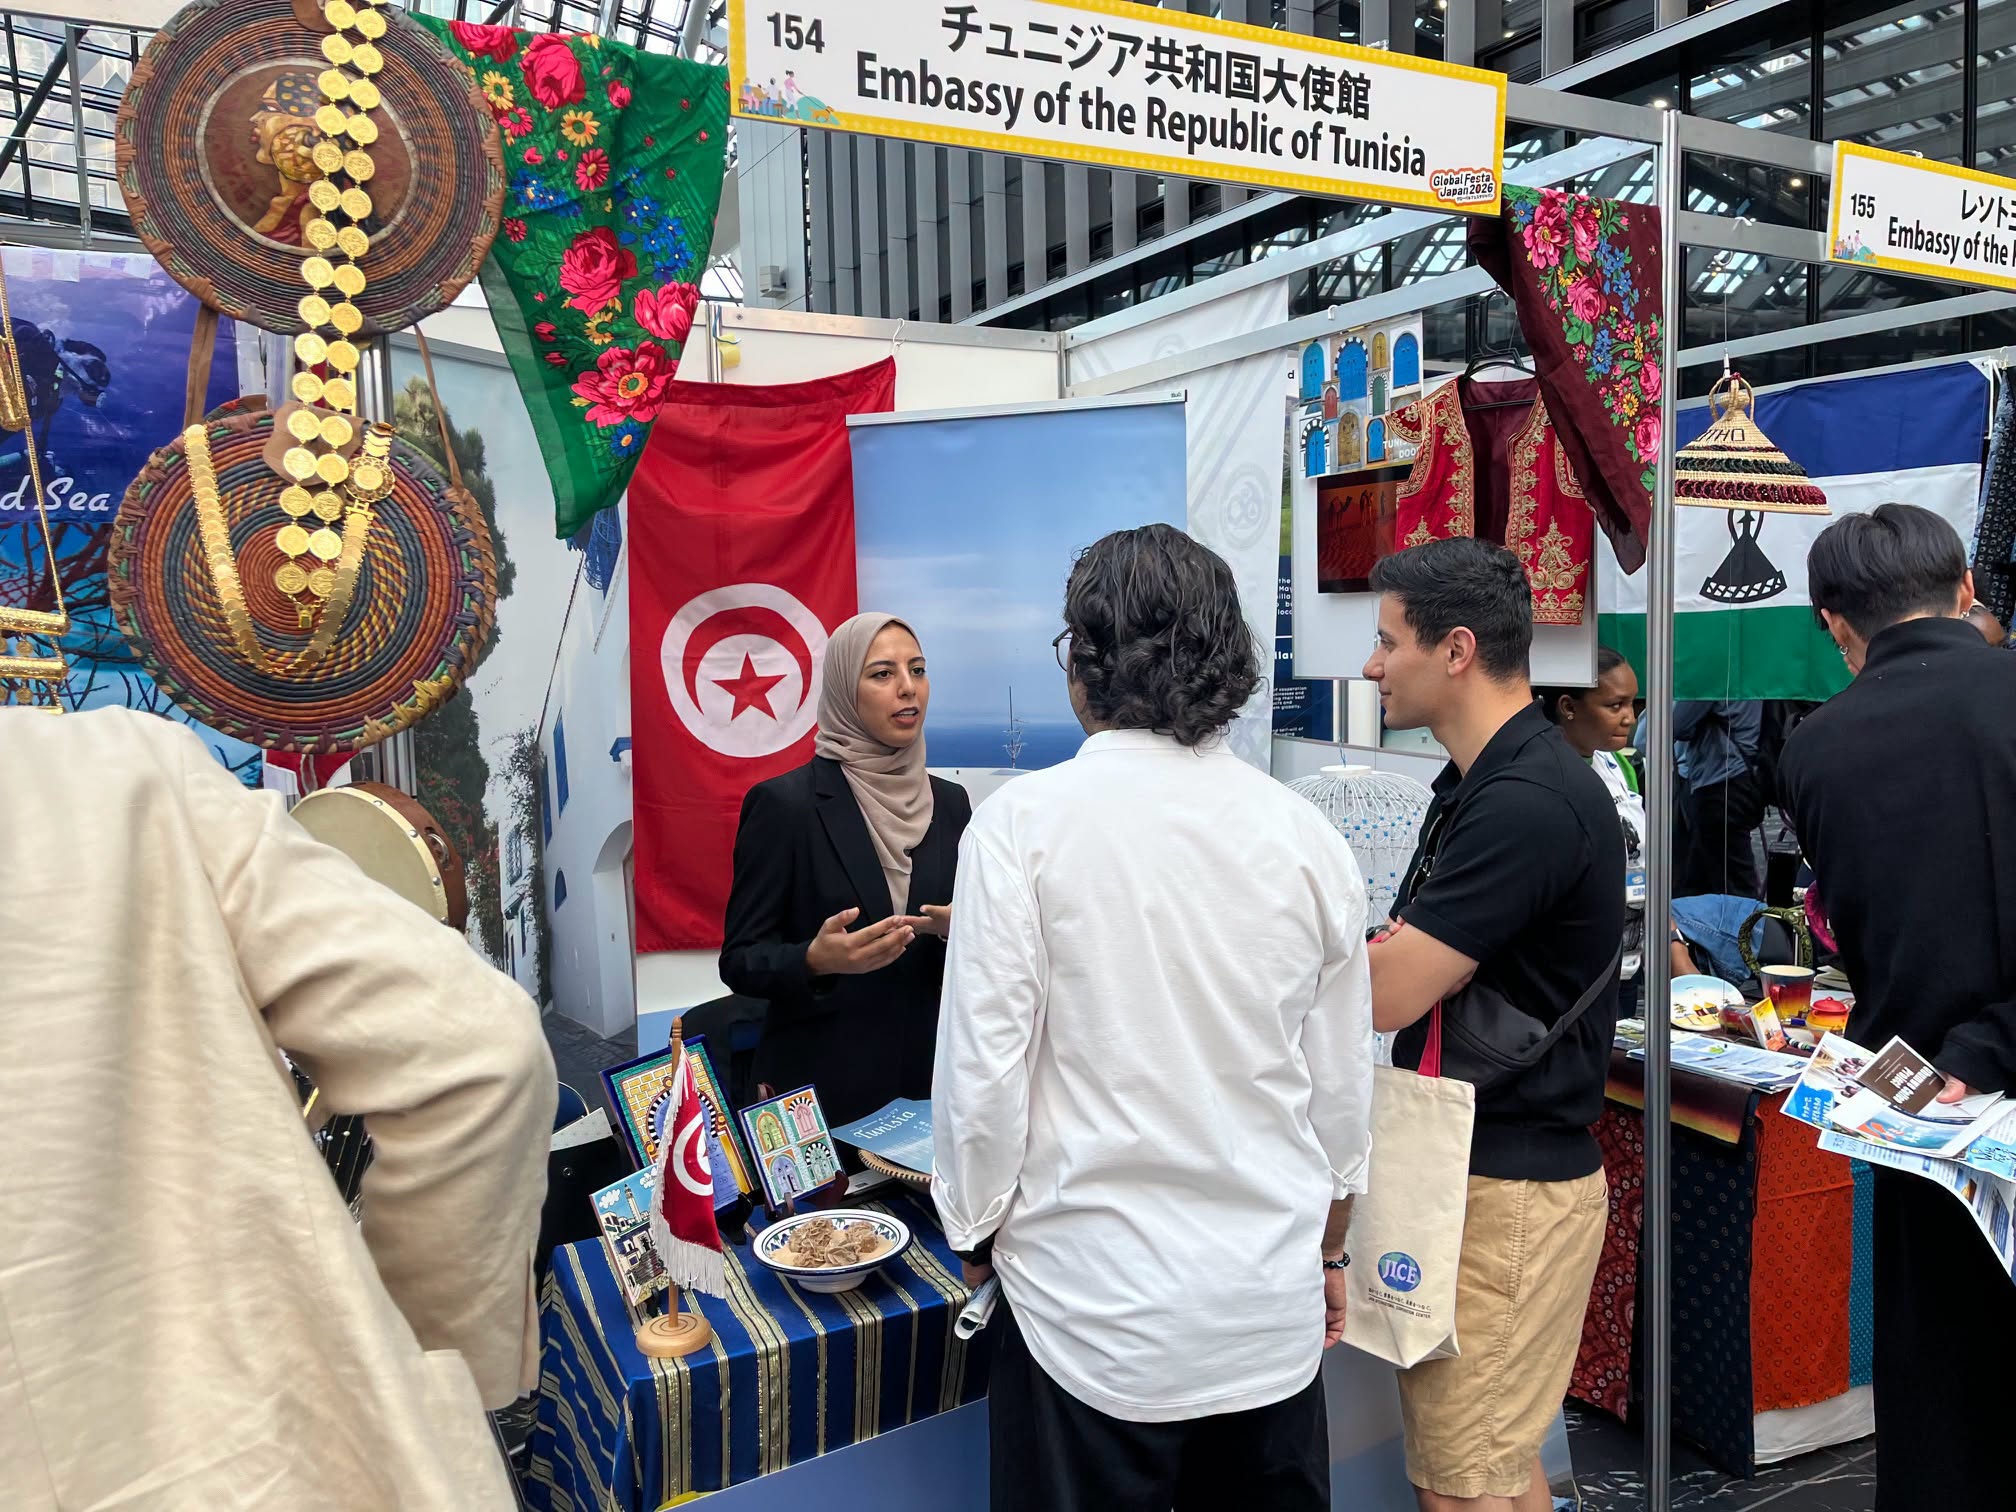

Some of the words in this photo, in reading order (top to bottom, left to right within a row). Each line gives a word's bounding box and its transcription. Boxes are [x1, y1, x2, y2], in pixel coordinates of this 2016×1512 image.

[766, 12, 825, 54] 154
[941, 4, 1371, 121] チュニジア共和国大使館
[857, 50, 1024, 131] Embassy
[1034, 81, 1072, 126] of
[1079, 86, 1136, 135] the
[1147, 96, 1283, 156] Republic
[1291, 120, 1323, 162] of
[1329, 124, 1426, 176] Tunisia
[1434, 174, 1463, 186] Global
[1464, 172, 1491, 186] Festa
[1440, 186, 1469, 197] Japan
[1469, 183, 1493, 194] 2026
[1851, 193, 1876, 218] 155
[1887, 216, 1960, 265] Embassy
[1963, 231, 1981, 260] of
[1983, 234, 2007, 266] the
[33, 477, 111, 512] Sea
[853, 1110, 917, 1140] Tunisia
[1382, 1259, 1418, 1285] JICE
